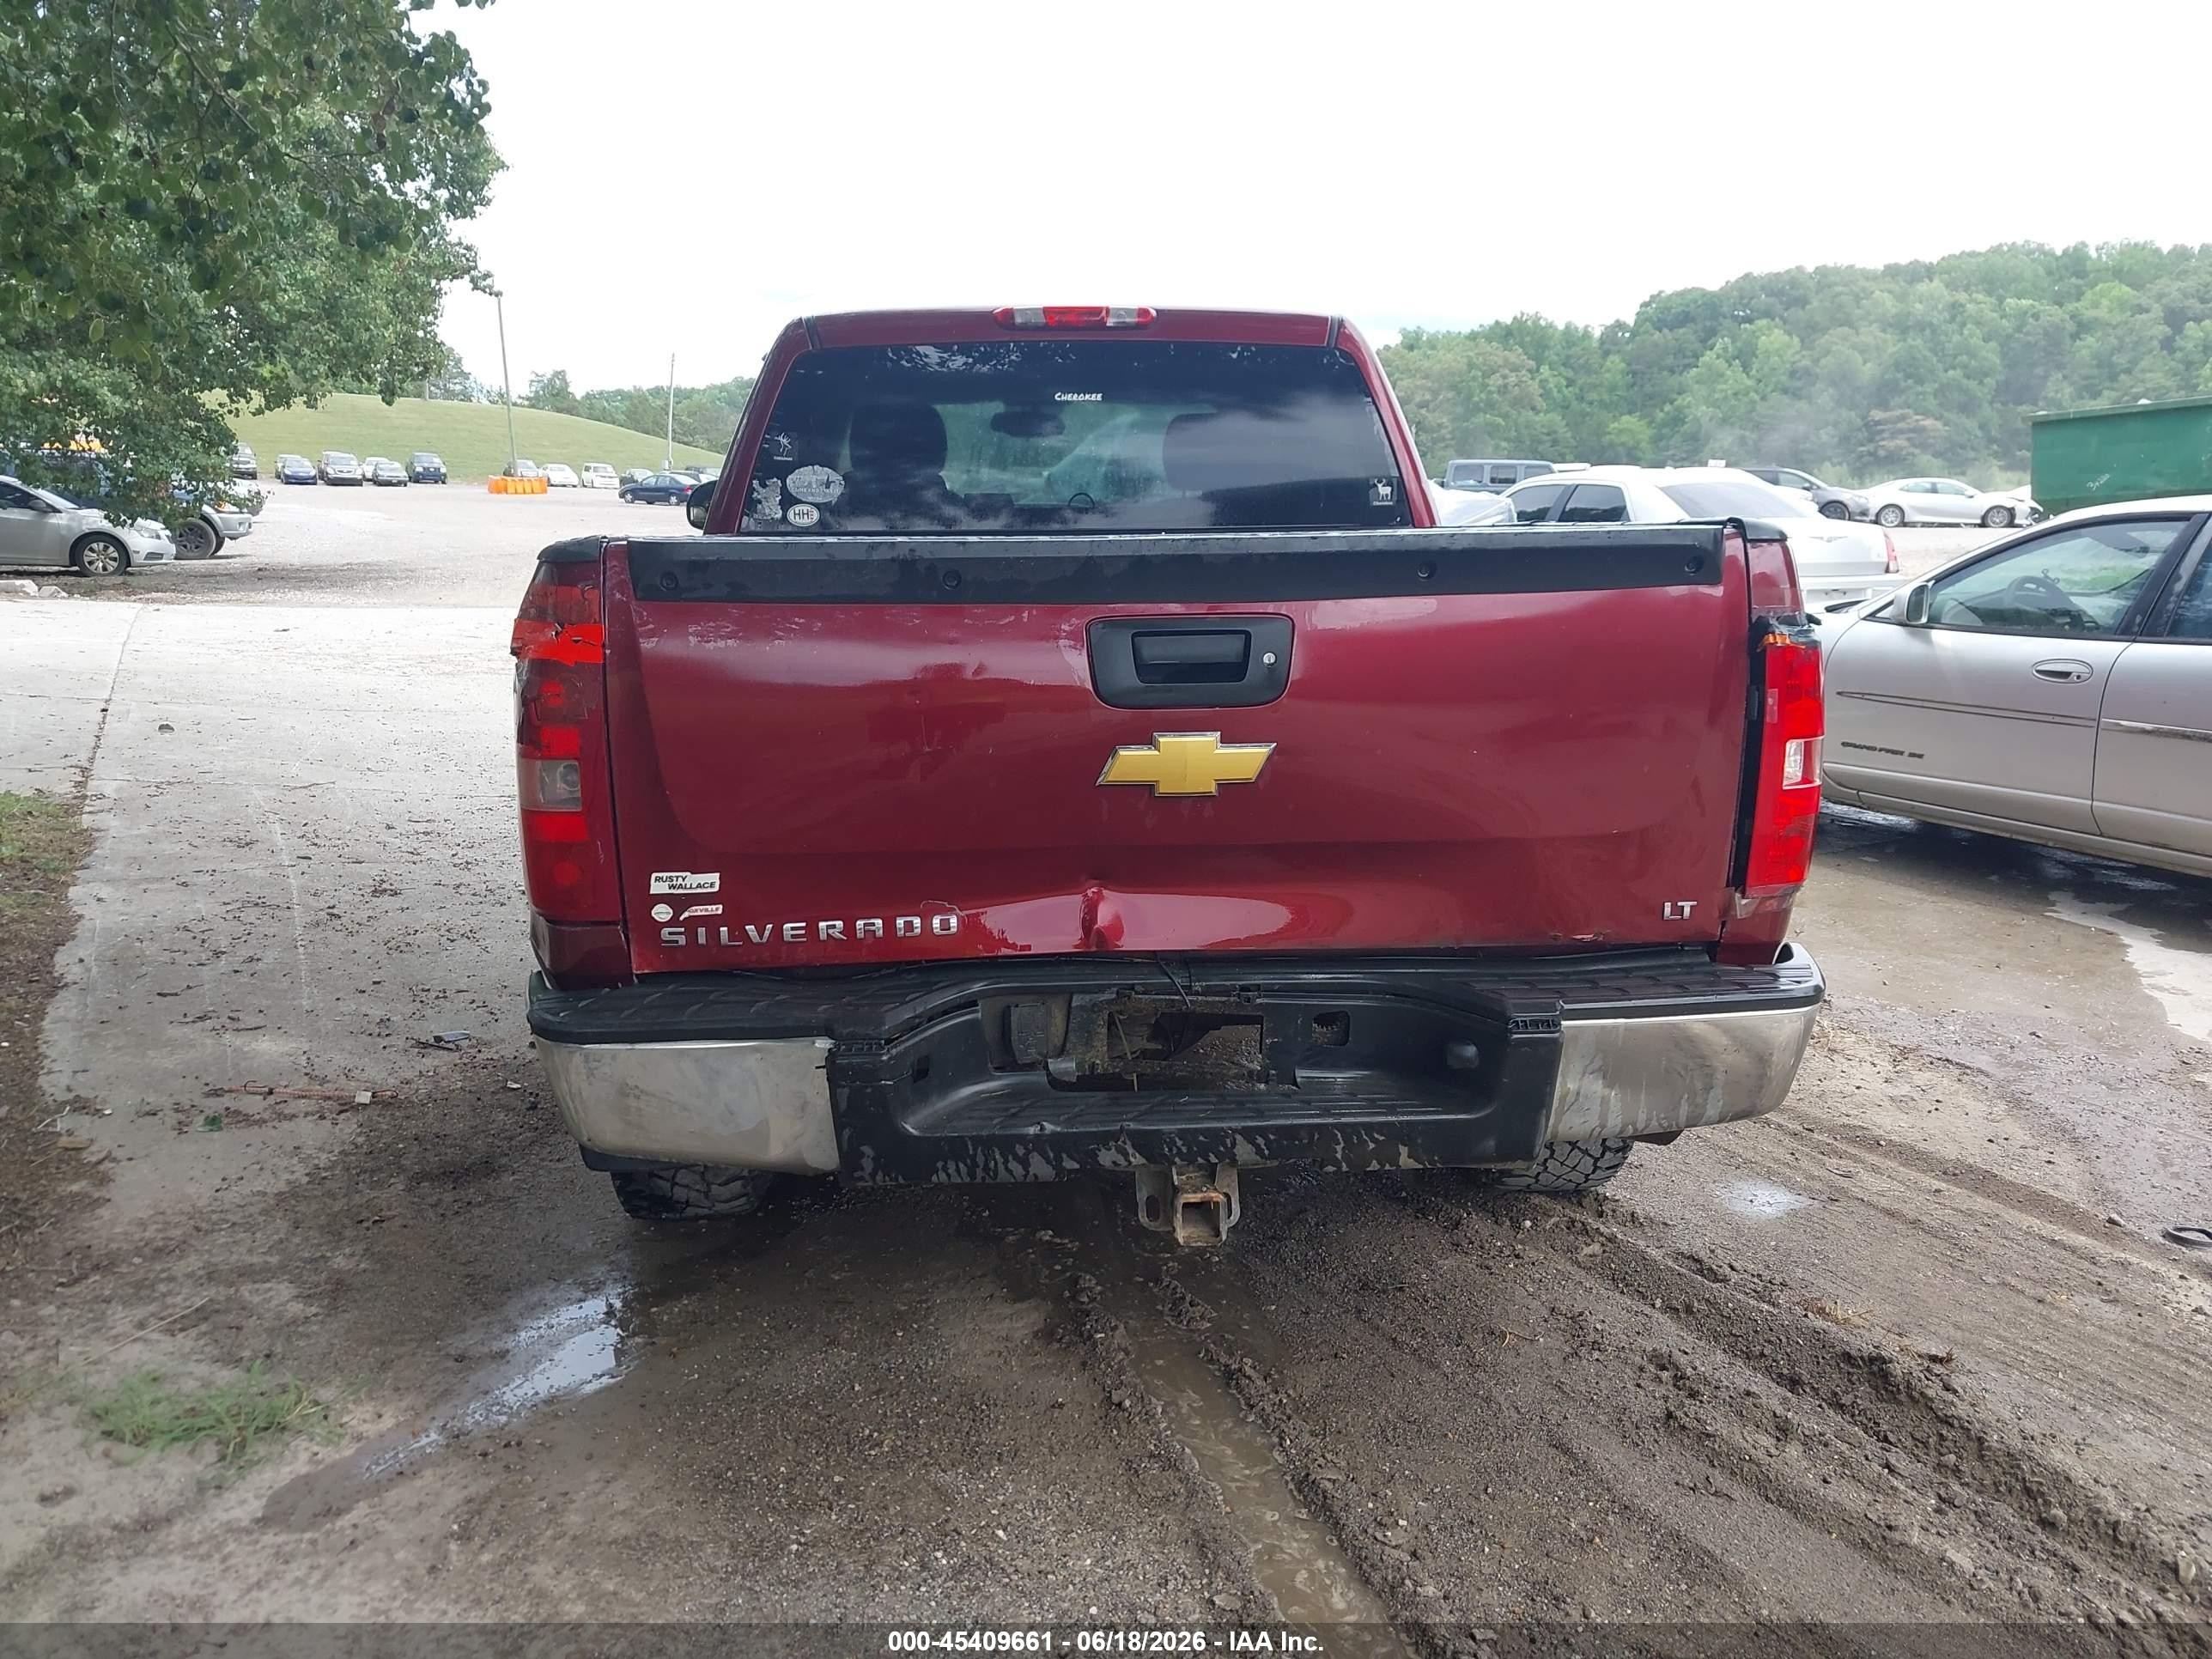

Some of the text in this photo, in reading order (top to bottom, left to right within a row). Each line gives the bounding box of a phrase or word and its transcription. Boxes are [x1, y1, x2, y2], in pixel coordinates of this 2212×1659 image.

[654, 875, 688, 884] RUSTY
[667, 881, 717, 890] WALLACE
[1663, 902, 1698, 921] LT
[660, 915, 957, 946] SILVERADO
